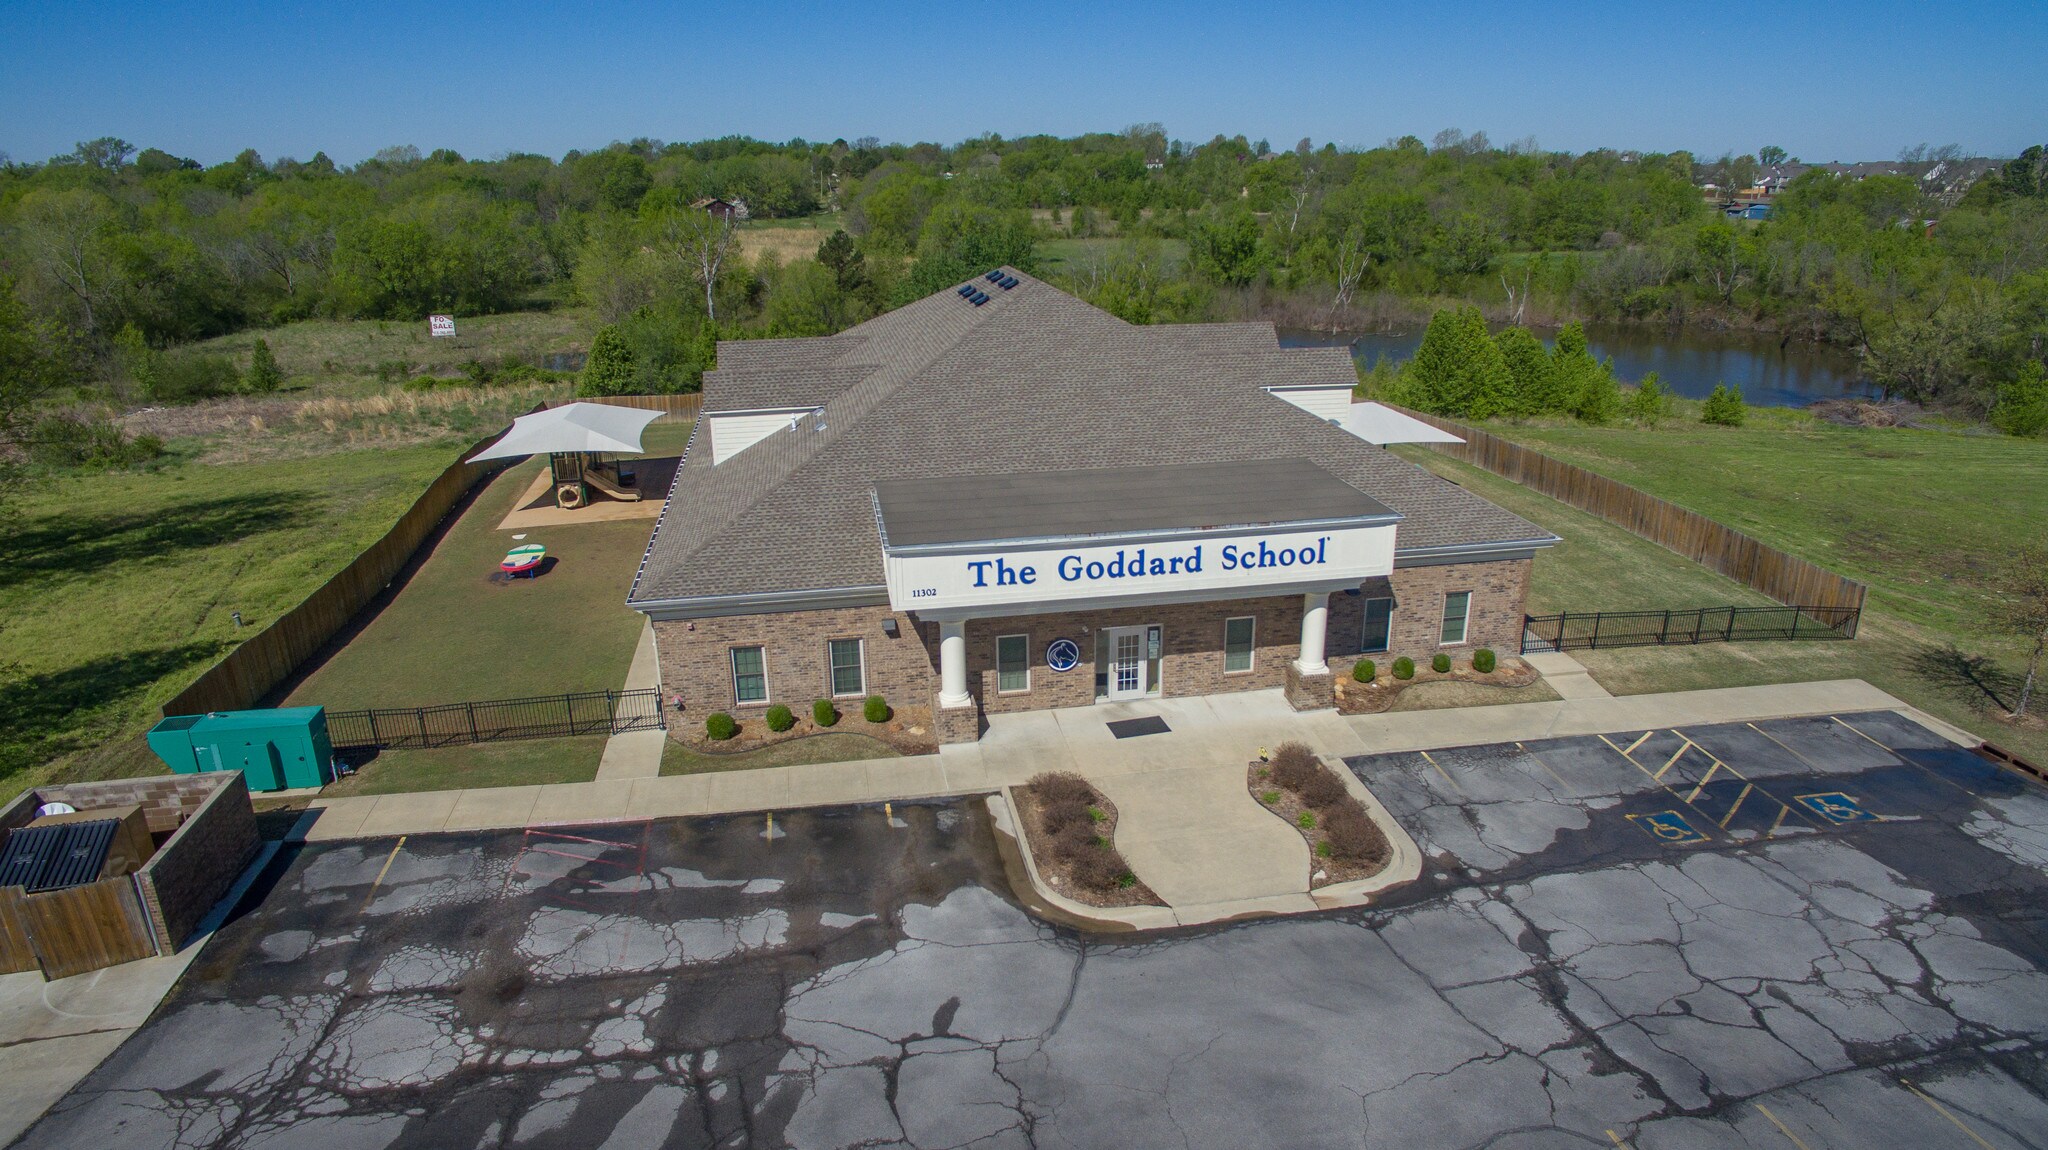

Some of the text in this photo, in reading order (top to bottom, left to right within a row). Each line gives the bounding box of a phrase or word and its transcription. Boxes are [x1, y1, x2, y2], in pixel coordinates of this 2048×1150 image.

[967, 537, 1327, 588] The Goddard School
[912, 588, 937, 597] 11302
